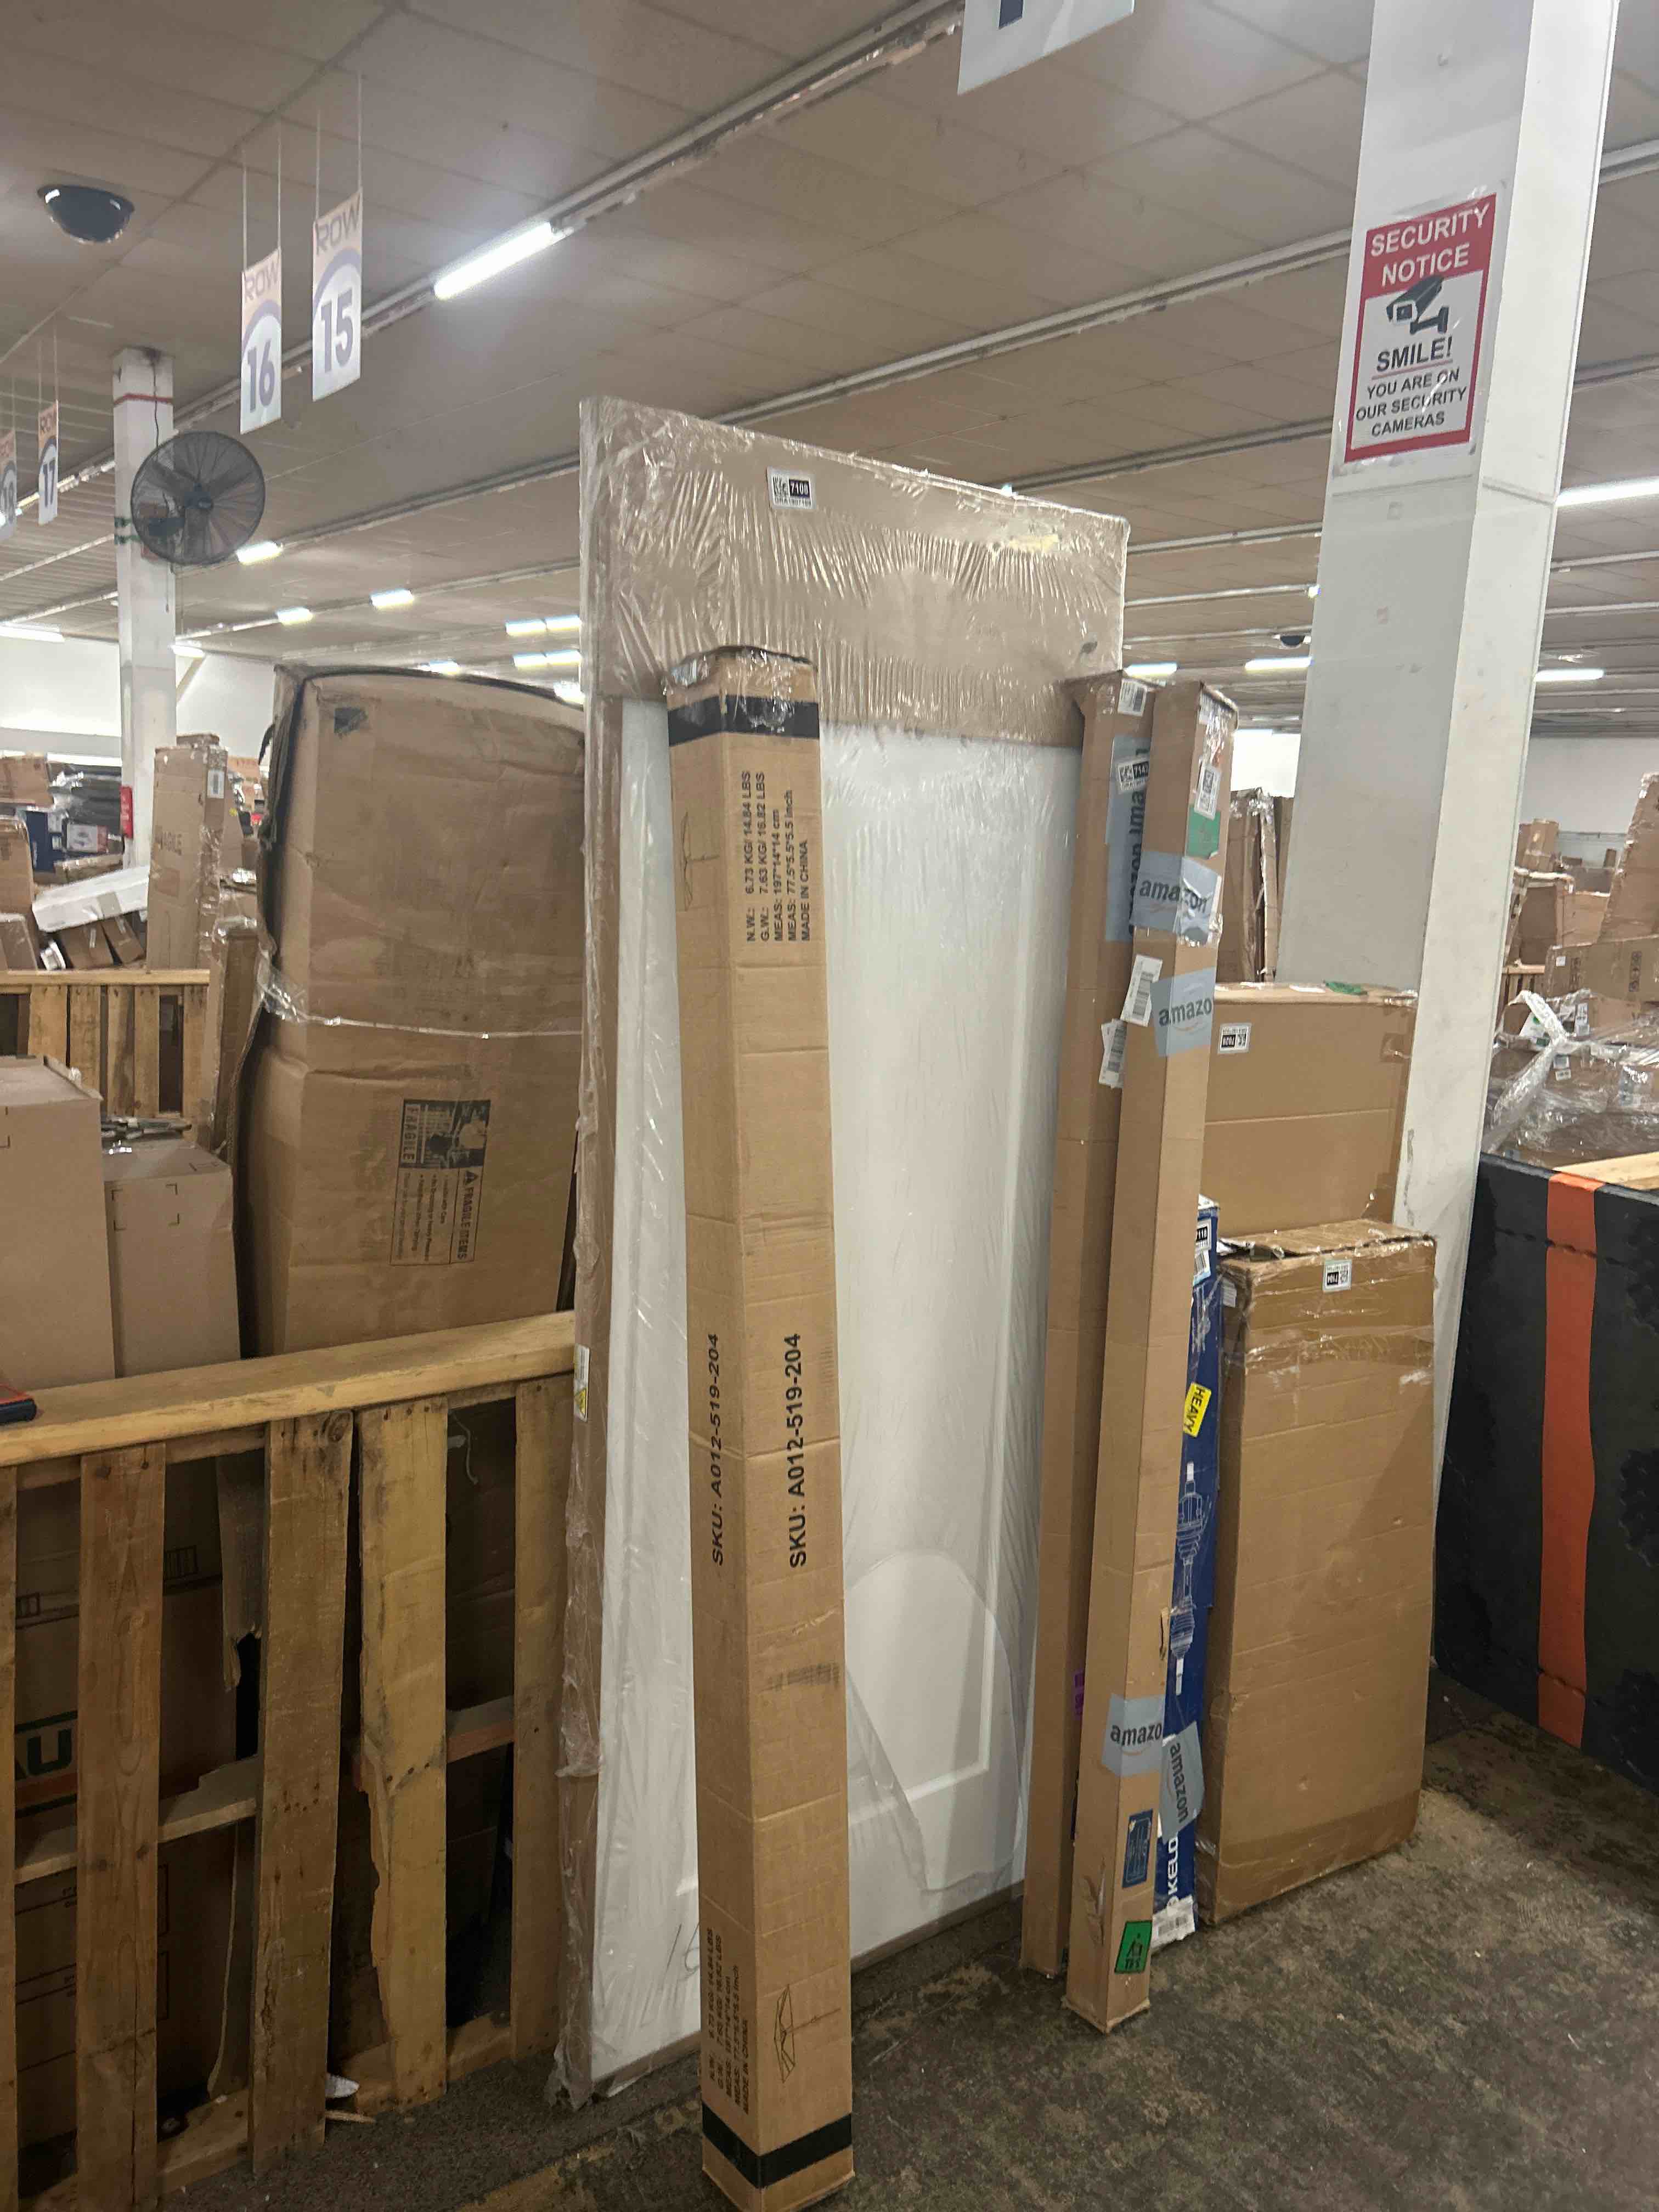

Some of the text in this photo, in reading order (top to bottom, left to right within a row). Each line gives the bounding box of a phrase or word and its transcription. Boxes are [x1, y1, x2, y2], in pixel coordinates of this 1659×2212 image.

[316, 195, 360, 255] ROW
[1371, 203, 1489, 257] SECURITY
[244, 260, 279, 300] ROW
[1381, 242, 1470, 287] NOTICE
[321, 289, 353, 374] 15
[1376, 336, 1453, 373] SMILE!
[248, 340, 274, 413] 16
[1367, 368, 1459, 400] YOU ARE ON
[1356, 386, 1468, 421] OUR SECURITY
[1372, 411, 1445, 436] CAMERAS
[43, 458, 55, 508] 17
[742, 771, 751, 799] LBS
[756, 772, 765, 800] LBS
[799, 839, 810, 941] MADE IN CHINA
[774, 899, 783, 941] MEAS:
[788, 899, 797, 941] MEAS:
[1158, 998, 1212, 1027] amazo
[1184, 1386, 1206, 1432] HEAVY
[708, 1334, 724, 1566] SKU: A012-519-204
[784, 1333, 806, 1568] SKU: A012-519-204
[1110, 1723, 1162, 1747] amazo
[1170, 1742, 1188, 1824] amazon
